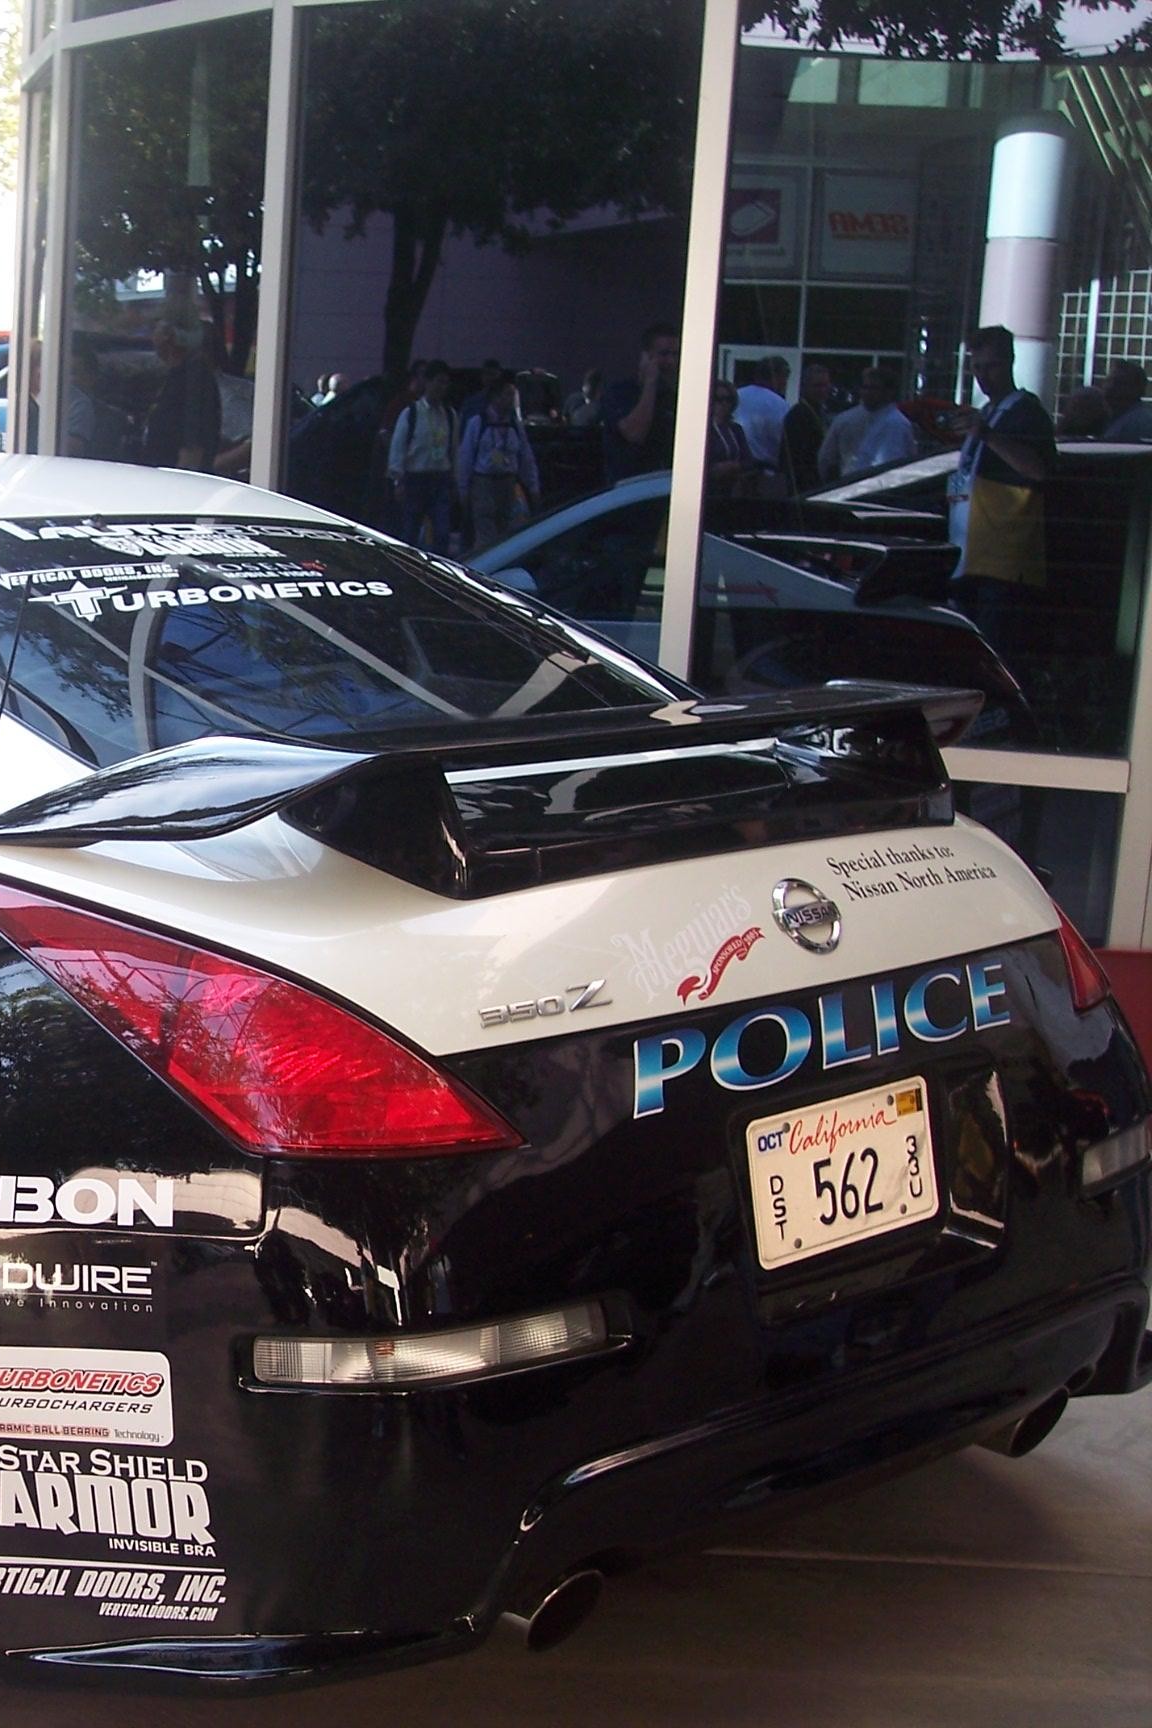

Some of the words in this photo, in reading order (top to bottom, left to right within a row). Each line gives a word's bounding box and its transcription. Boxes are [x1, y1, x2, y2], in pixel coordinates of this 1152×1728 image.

[28, 581, 394, 622] TURBONETICS
[827, 849, 886, 878] Special
[887, 844, 933, 866] thanks
[842, 879, 899, 902] Nissan
[896, 867, 943, 891] North
[945, 863, 998, 883] America
[633, 962, 1012, 1120] POLICE
[757, 1131, 784, 1152] OCT
[789, 1104, 900, 1156] California
[812, 1147, 884, 1226] 562
[40, 1297, 154, 1313] Innovation
[34, 1424, 63, 1435] BALL
[63, 1426, 111, 1438] BEARING
[108, 1537, 180, 1555] INVISIBLE
[184, 1542, 217, 1558] BRA
[74, 1568, 167, 1606] DOORS,
[174, 1574, 228, 1605] INC.
[98, 1601, 219, 1623] VERTICALDOORS.COM
